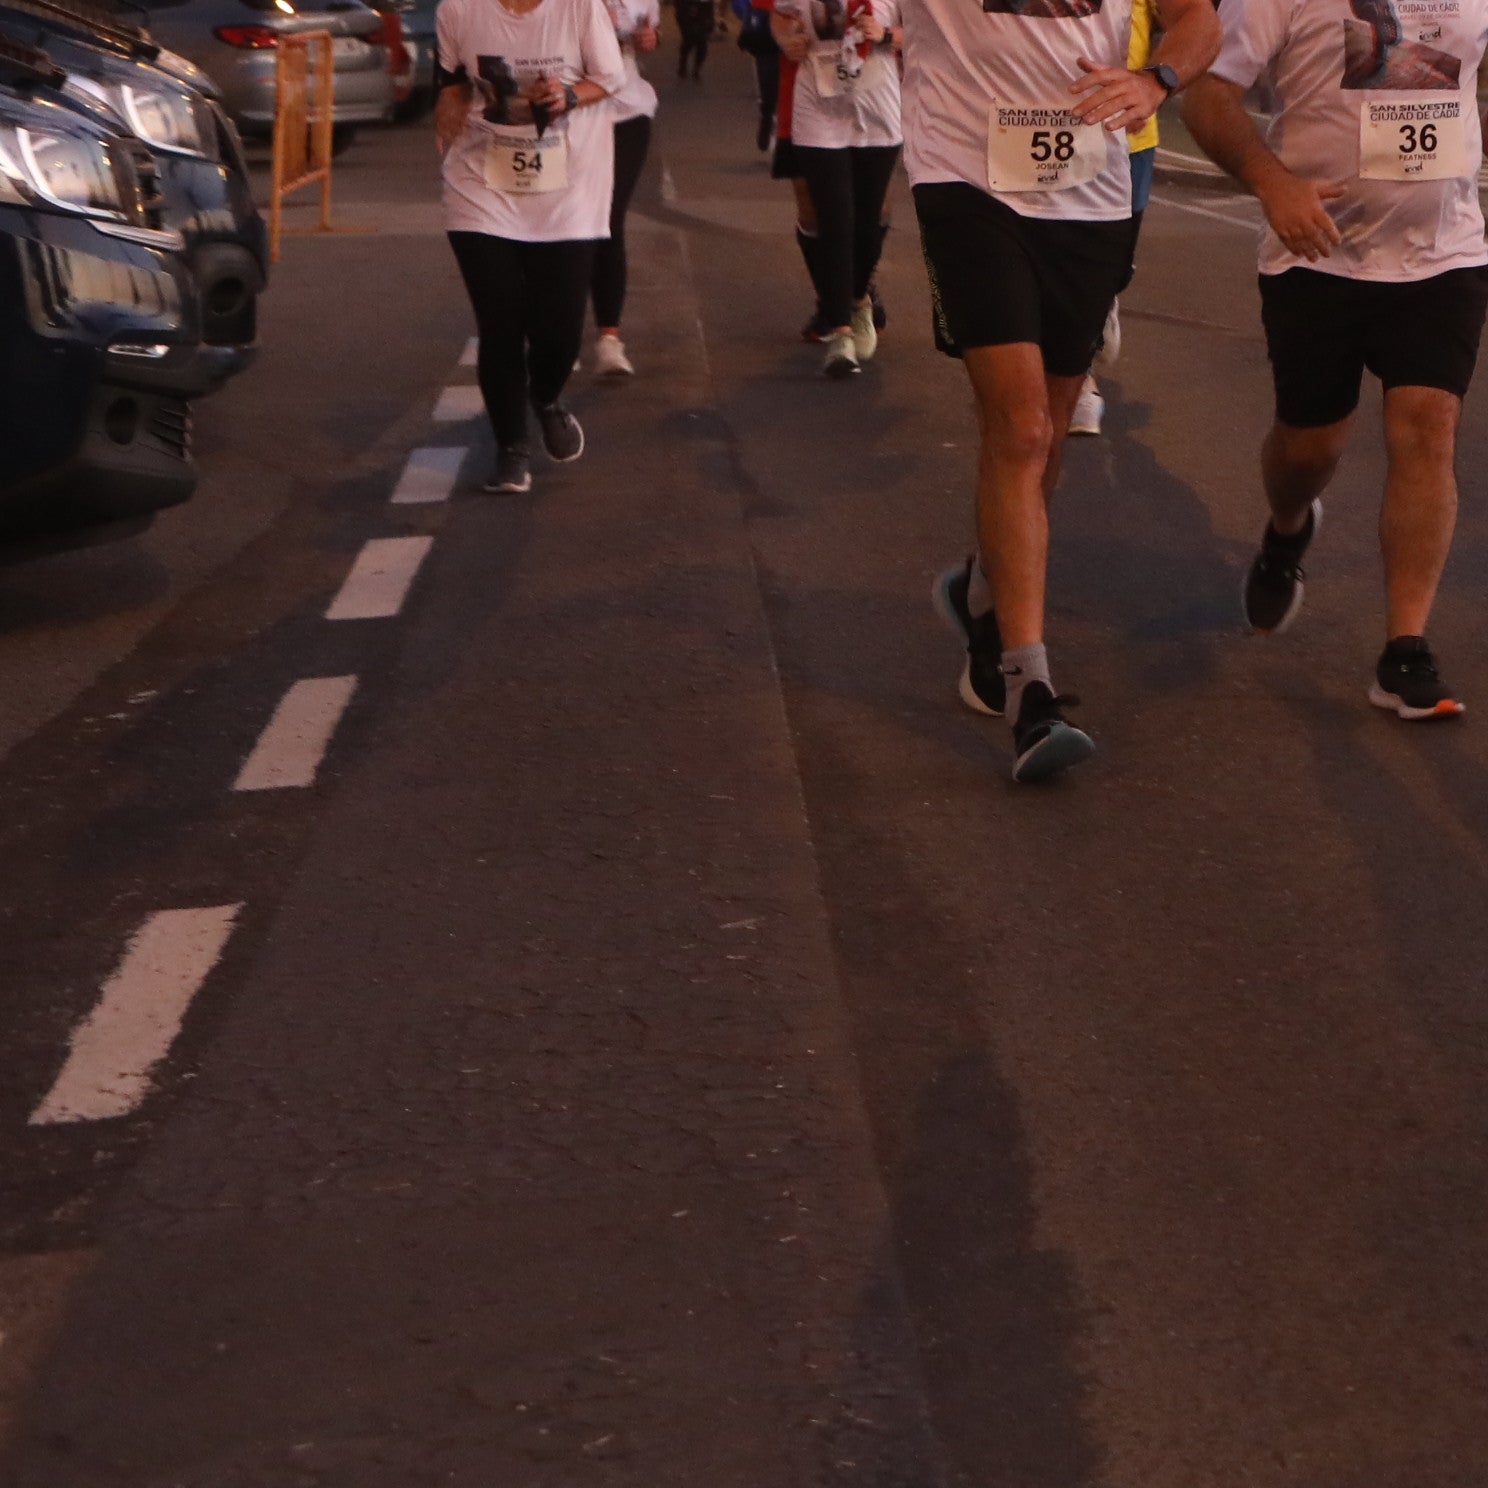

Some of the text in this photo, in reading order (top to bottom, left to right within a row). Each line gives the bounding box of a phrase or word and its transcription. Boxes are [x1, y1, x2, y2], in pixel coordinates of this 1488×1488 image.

[1398, 4, 1426, 13] CIUDAD
[1428, 4, 1438, 12] DE
[1370, 102, 1460, 112] SAN SILVESTRE
[1031, 109, 1072, 117] SILVE
[1370, 111, 1413, 121] CIUDAD
[1416, 111, 1430, 120] DE
[999, 116, 1046, 126] CIUDAD
[1050, 117, 1066, 126] DE
[1399, 123, 1438, 153] 36
[1030, 131, 1075, 162] 58
[513, 152, 542, 173] 54
